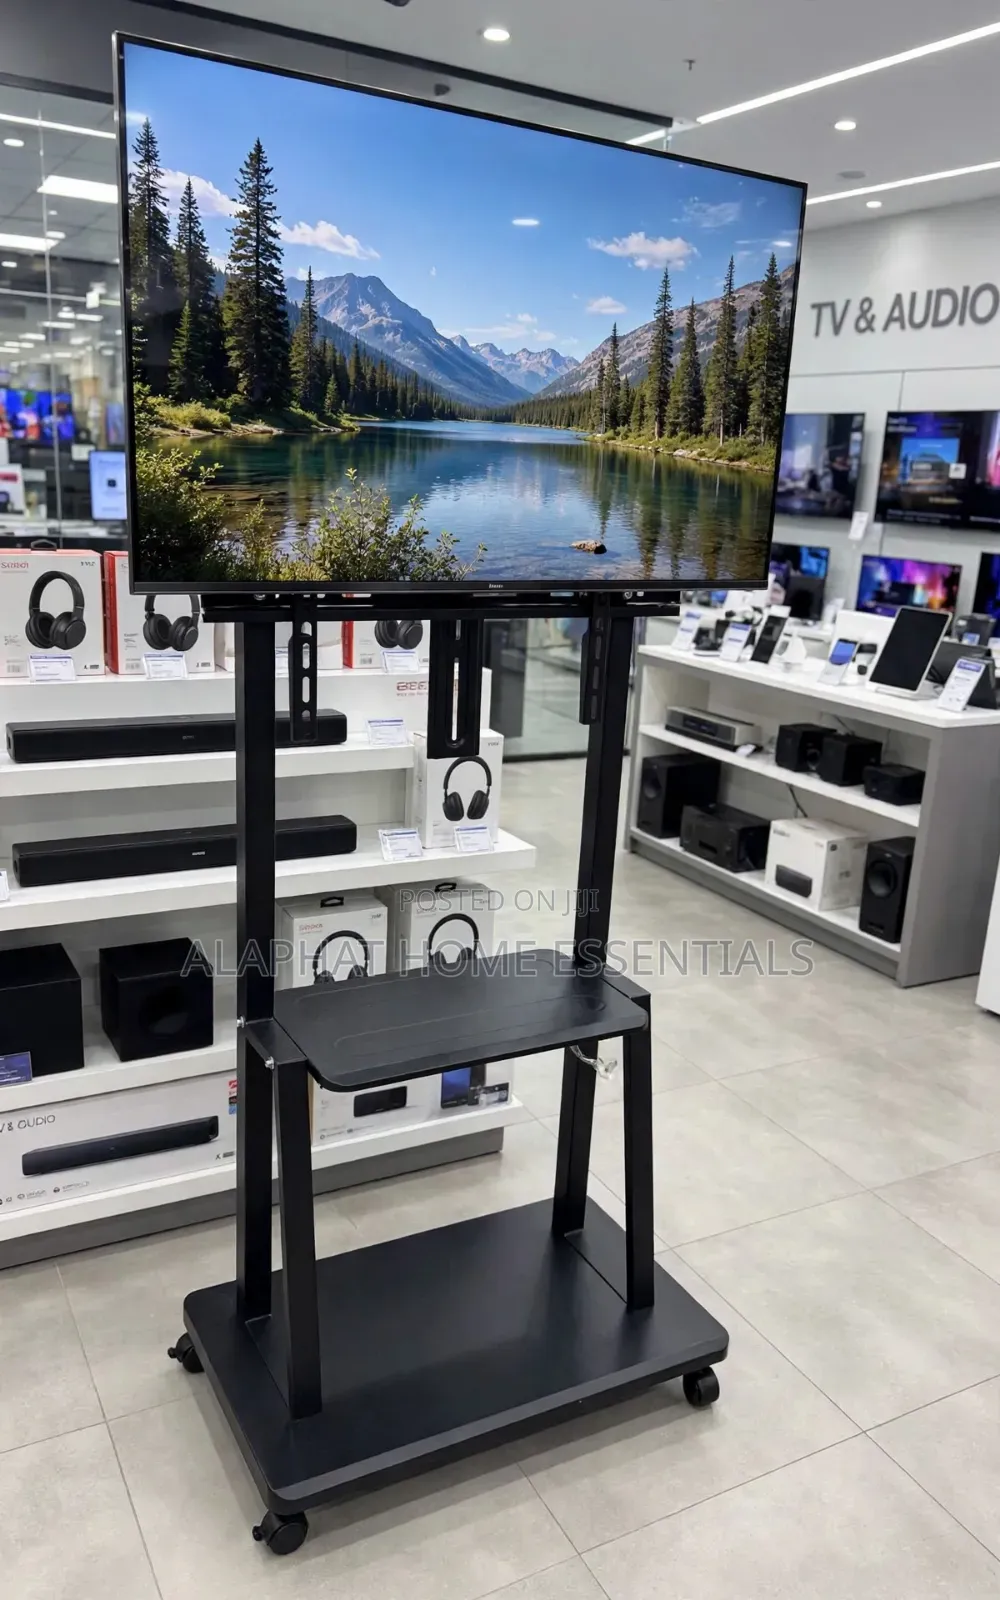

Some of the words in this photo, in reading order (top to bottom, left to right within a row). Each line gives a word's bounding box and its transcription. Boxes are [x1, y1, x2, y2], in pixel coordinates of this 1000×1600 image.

[810, 299, 852, 338] TV
[854, 296, 876, 334] &
[882, 282, 1000, 332] AUDIO
